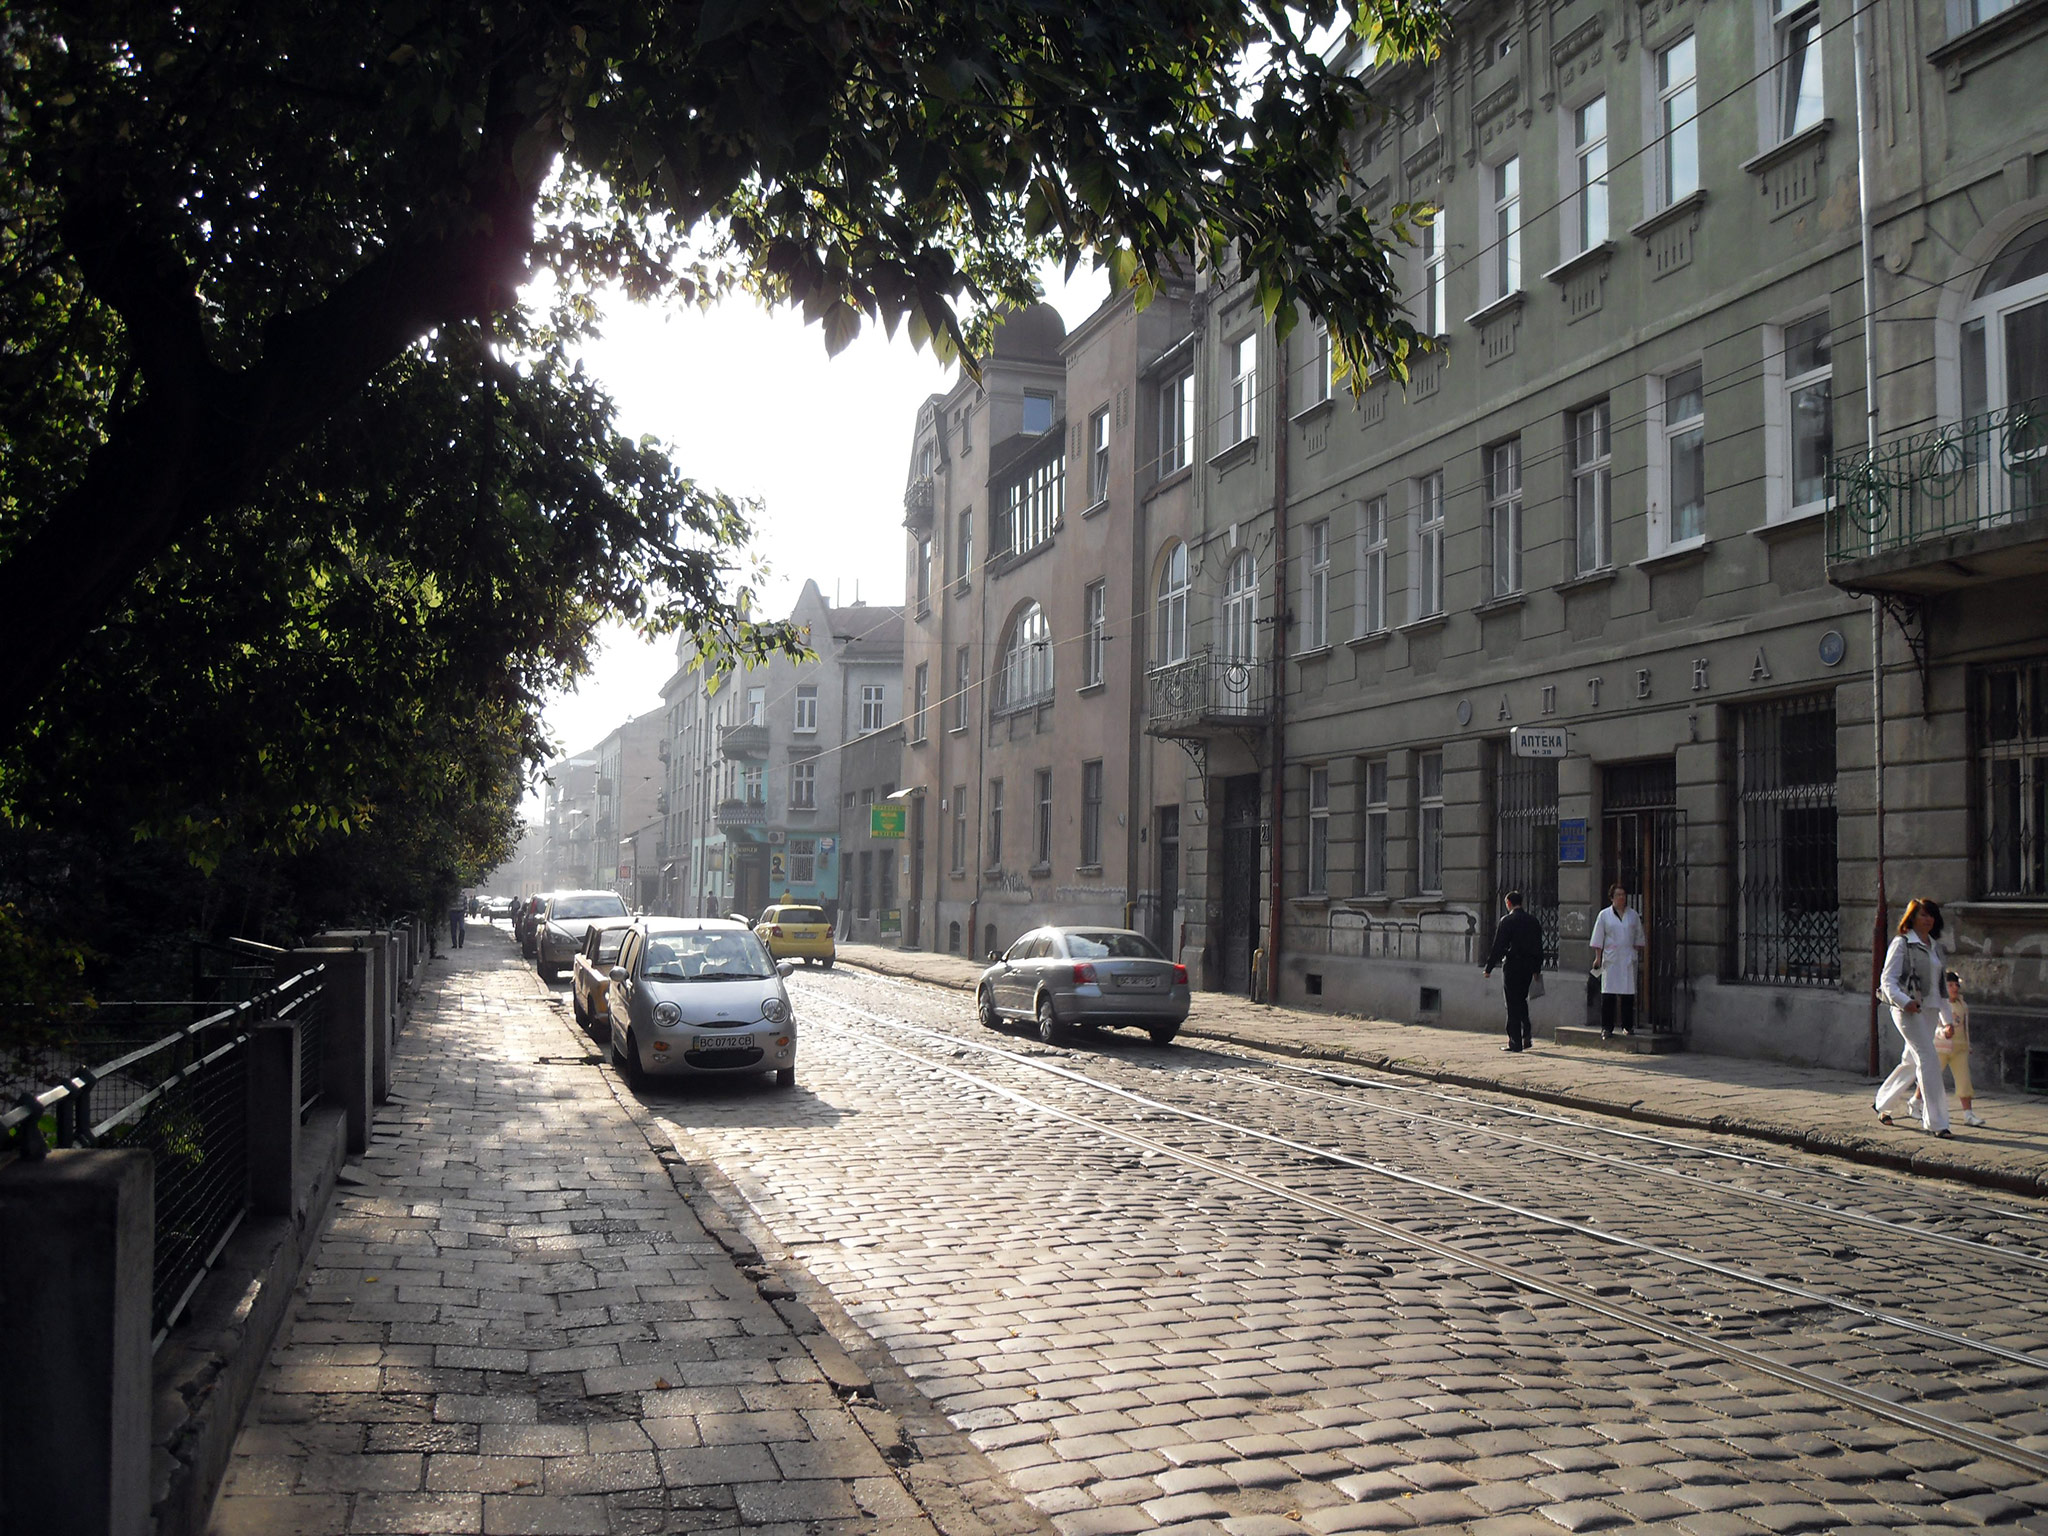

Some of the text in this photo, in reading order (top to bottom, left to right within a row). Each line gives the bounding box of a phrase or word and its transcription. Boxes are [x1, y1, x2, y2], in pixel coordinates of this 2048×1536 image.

[1497, 646, 1771, 720] АПТЕКА
[1521, 735, 1562, 747] АПТЕКА
[700, 1036, 752, 1048] BC 0712 CB
